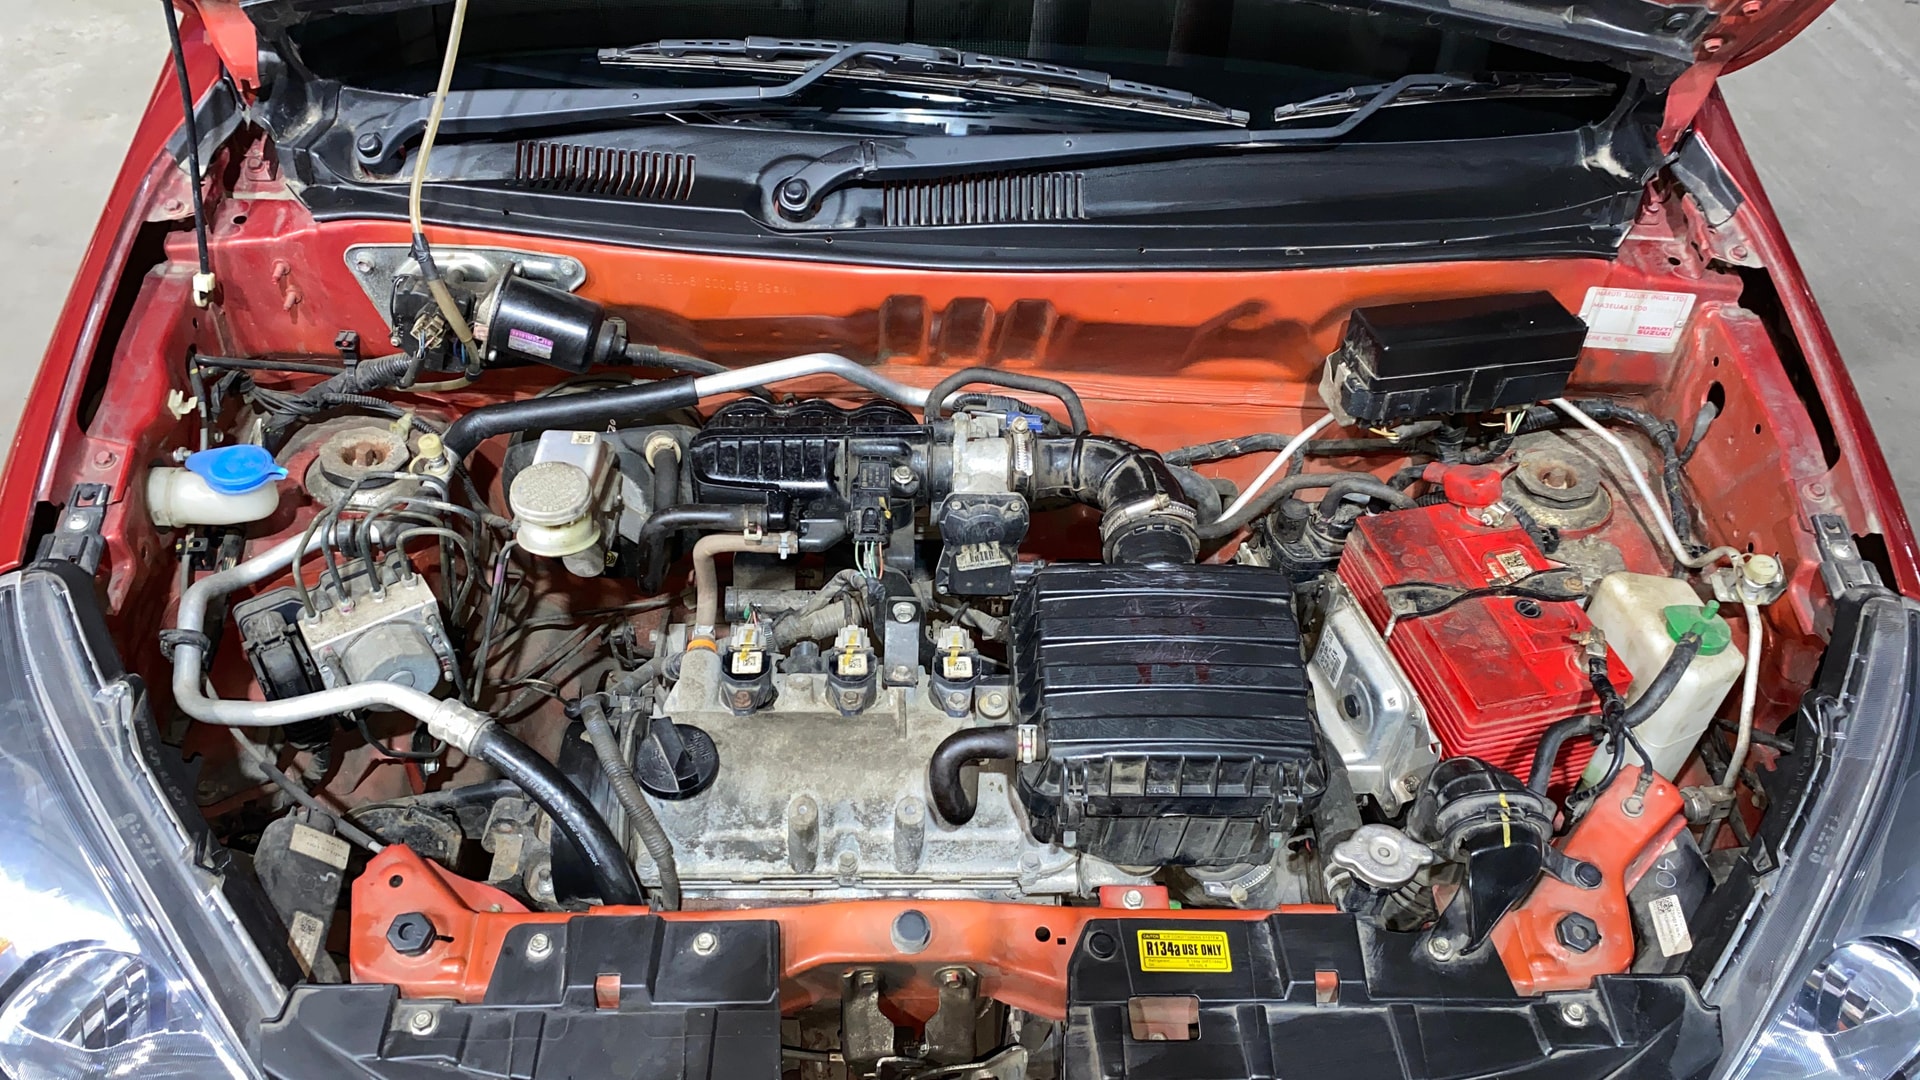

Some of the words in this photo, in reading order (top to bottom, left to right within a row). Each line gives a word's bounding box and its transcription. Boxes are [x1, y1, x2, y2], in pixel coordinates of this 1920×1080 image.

[1598, 289, 1621, 297] MARUTI
[1624, 291, 1649, 299] SUZUKI
[549, 799, 562, 813] ONLY
[1146, 941, 1180, 956] R134a
[1182, 944, 1198, 955] USE
[1201, 944, 1221, 956] ONLY
